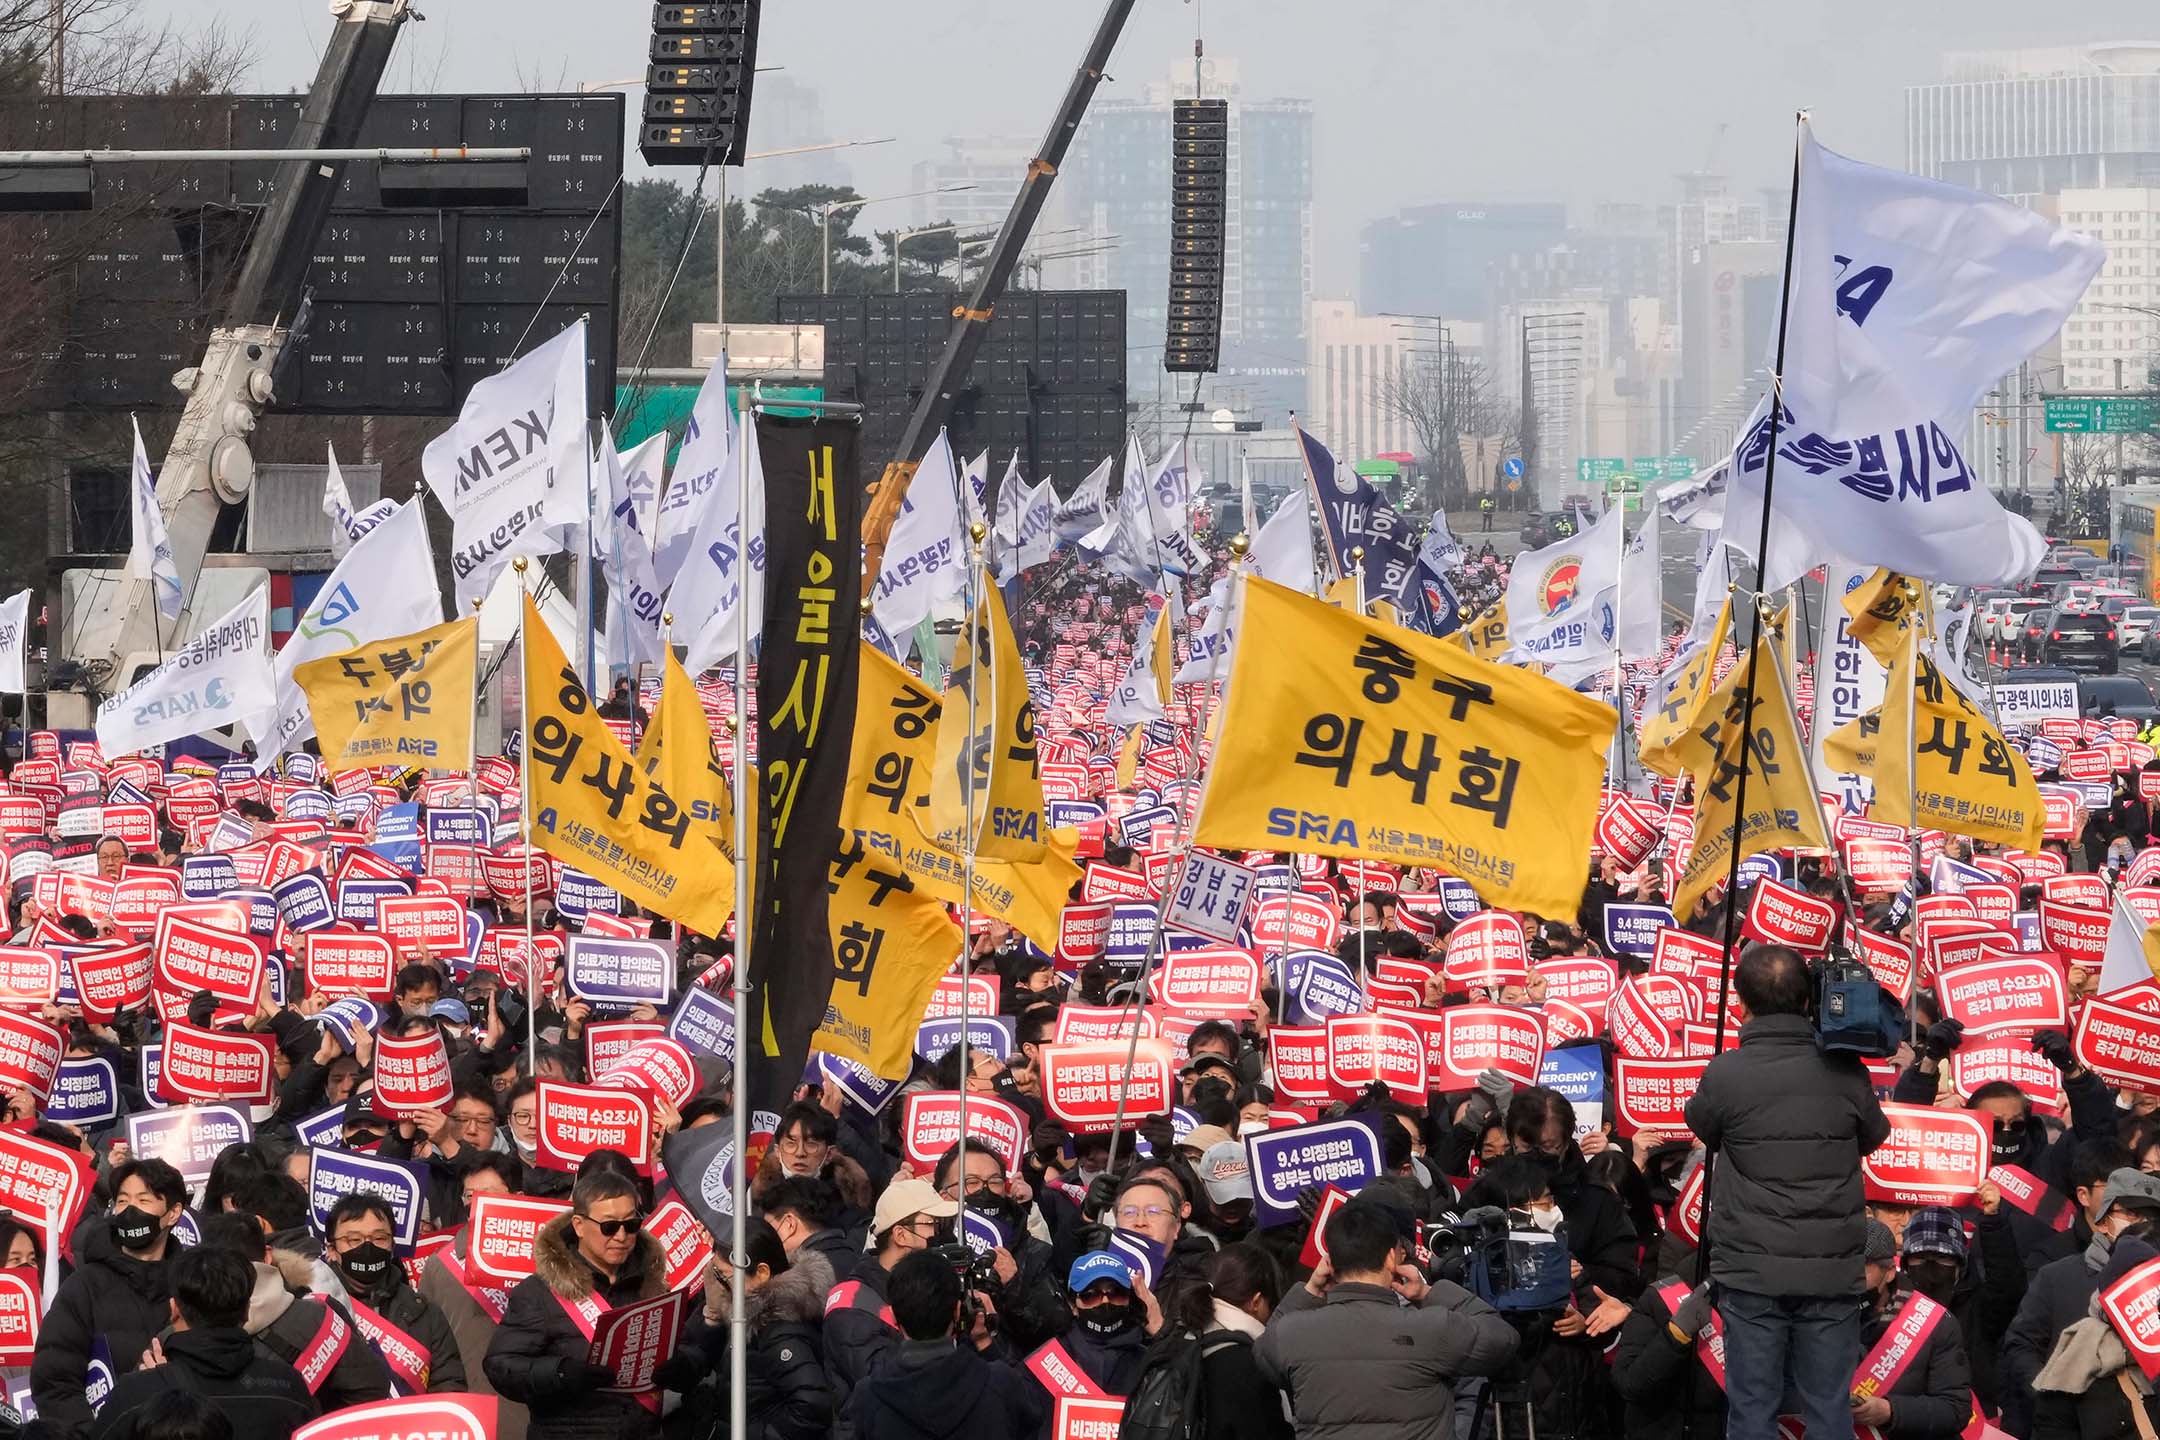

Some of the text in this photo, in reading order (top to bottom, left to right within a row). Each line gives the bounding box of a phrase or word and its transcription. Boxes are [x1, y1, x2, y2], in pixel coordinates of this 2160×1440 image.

[1351, 632, 1497, 724] 중구
[1996, 688, 2074, 713] 구광역시의사회
[533, 713, 690, 850] 의사회
[1294, 712, 1522, 830] 의사회
[993, 807, 1038, 842] SMA
[1266, 807, 1359, 849] SMA
[52, 843, 93, 857] WANTED
[562, 819, 678, 893] 서울특별시의사회
[1367, 826, 1517, 881] 서울특별시의사회
[1368, 842, 1402, 856] SEOUL
[560, 833, 669, 898] SEOUL MEDICAL ASSOCIATION
[343, 905, 374, 918] 의대증원
[585, 896, 616, 909] 결사반대
[1762, 892, 1829, 926] 비과학적 수요조사
[387, 910, 456, 925] 일방적인 정책추진
[1065, 920, 1093, 933] 준비안된
[1292, 911, 1329, 930] 수요조사
[1617, 917, 1632, 929] 9.4
[1764, 911, 1817, 938] 즉각 폐기하라
[2046, 916, 2077, 936] 비과학적
[423, 924, 457, 938] 위협한다
[1064, 934, 1092, 946] 의학교육
[1450, 931, 1481, 949] 의대정원
[1613, 930, 1636, 944] 정부는
[170, 935, 254, 970] 의대정원 졸속확대
[314, 948, 385, 963] 준비안된 의대증원
[576, 952, 661, 972] 의료계와 합의없는
[1447, 948, 1483, 965] 의료체계
[11, 961, 49, 977] 정책추진
[84, 965, 122, 985] 일방적인
[167, 952, 250, 987] 의료체계 붕괴된다
[313, 963, 385, 979] 의학교육 훼손된다
[576, 968, 661, 988] 의대증원 결사반대
[1171, 966, 1250, 980] 의대정원 졸속확대
[1570, 970, 1608, 982] 졸속확대
[11, 976, 48, 989] 위협한다
[87, 980, 126, 1000] 국민건강
[1169, 980, 1248, 995] 의료체계 붕괴된다
[1312, 973, 1350, 1000] 의료계와
[1569, 983, 1608, 997] 붕괴된다
[1951, 974, 2051, 1002] 비과학적 수요조사
[1307, 988, 1347, 1013] 의대증원
[1967, 992, 2042, 1016] 즉각 폐기하라
[688, 1003, 722, 1032] 의료계와
[681, 1020, 714, 1048] 의대증원
[932, 1034, 949, 1046] 9.4
[1068, 1021, 1108, 1038] 준비안된
[1453, 1023, 1538, 1047] 의대정원 졸속확대
[2089, 1019, 2136, 1044] 비과학적
[172, 1041, 260, 1066] 의대정원 졸속확대
[1277, 1045, 1313, 1063] 의대정원
[1334, 1034, 1418, 1058] 일방적인 정책추진
[1452, 1045, 1534, 1068] 의료체계 붕괴된다
[2095, 1039, 2119, 1058] 즉각
[378, 1052, 446, 1074] 의대정원 졸속확대
[1335, 1053, 1418, 1074] 국민건강 위협한다
[1963, 1050, 2008, 1067] 의대정원
[170, 1059, 259, 1083] 의료체계 붕괴된다
[1056, 1063, 1106, 1084] 의대정원
[1278, 1064, 1313, 1079] 의료체계
[1963, 1066, 2054, 1087] 의료체계 붕괴된다
[60, 1074, 100, 1091] 의정합의
[377, 1074, 416, 1093] 의료체계
[1627, 1076, 1671, 1093] 일방적인
[67, 1092, 107, 1109] 이행하라
[1057, 1084, 1107, 1103] 의료체계
[548, 1101, 639, 1126] 비과학적 수요조사
[1627, 1097, 1671, 1112] 국민건강
[557, 1123, 626, 1146] 즉각 폐기하라
[969, 1111, 1016, 1141] 졸속확대
[1923, 1131, 1977, 1152] 의대증원
[1276, 1138, 1353, 1168] 9.4 의정합의
[1869, 1149, 1977, 1173] 의학교육 훼손된다
[17, 1160, 69, 1191] 의대증원
[315, 1168, 356, 1190] 의료계와
[1272, 1158, 1365, 1191] 정부는 이행하라
[1988, 1166, 2033, 1200] 의대정원
[484, 1217, 534, 1239] 준비안된
[483, 1238, 533, 1260] 의학교육
[380, 1334, 425, 1375] 정책추진
[1869, 1333, 1911, 1381] 정책추진
[1041, 1351, 1080, 1395] 의대정원
